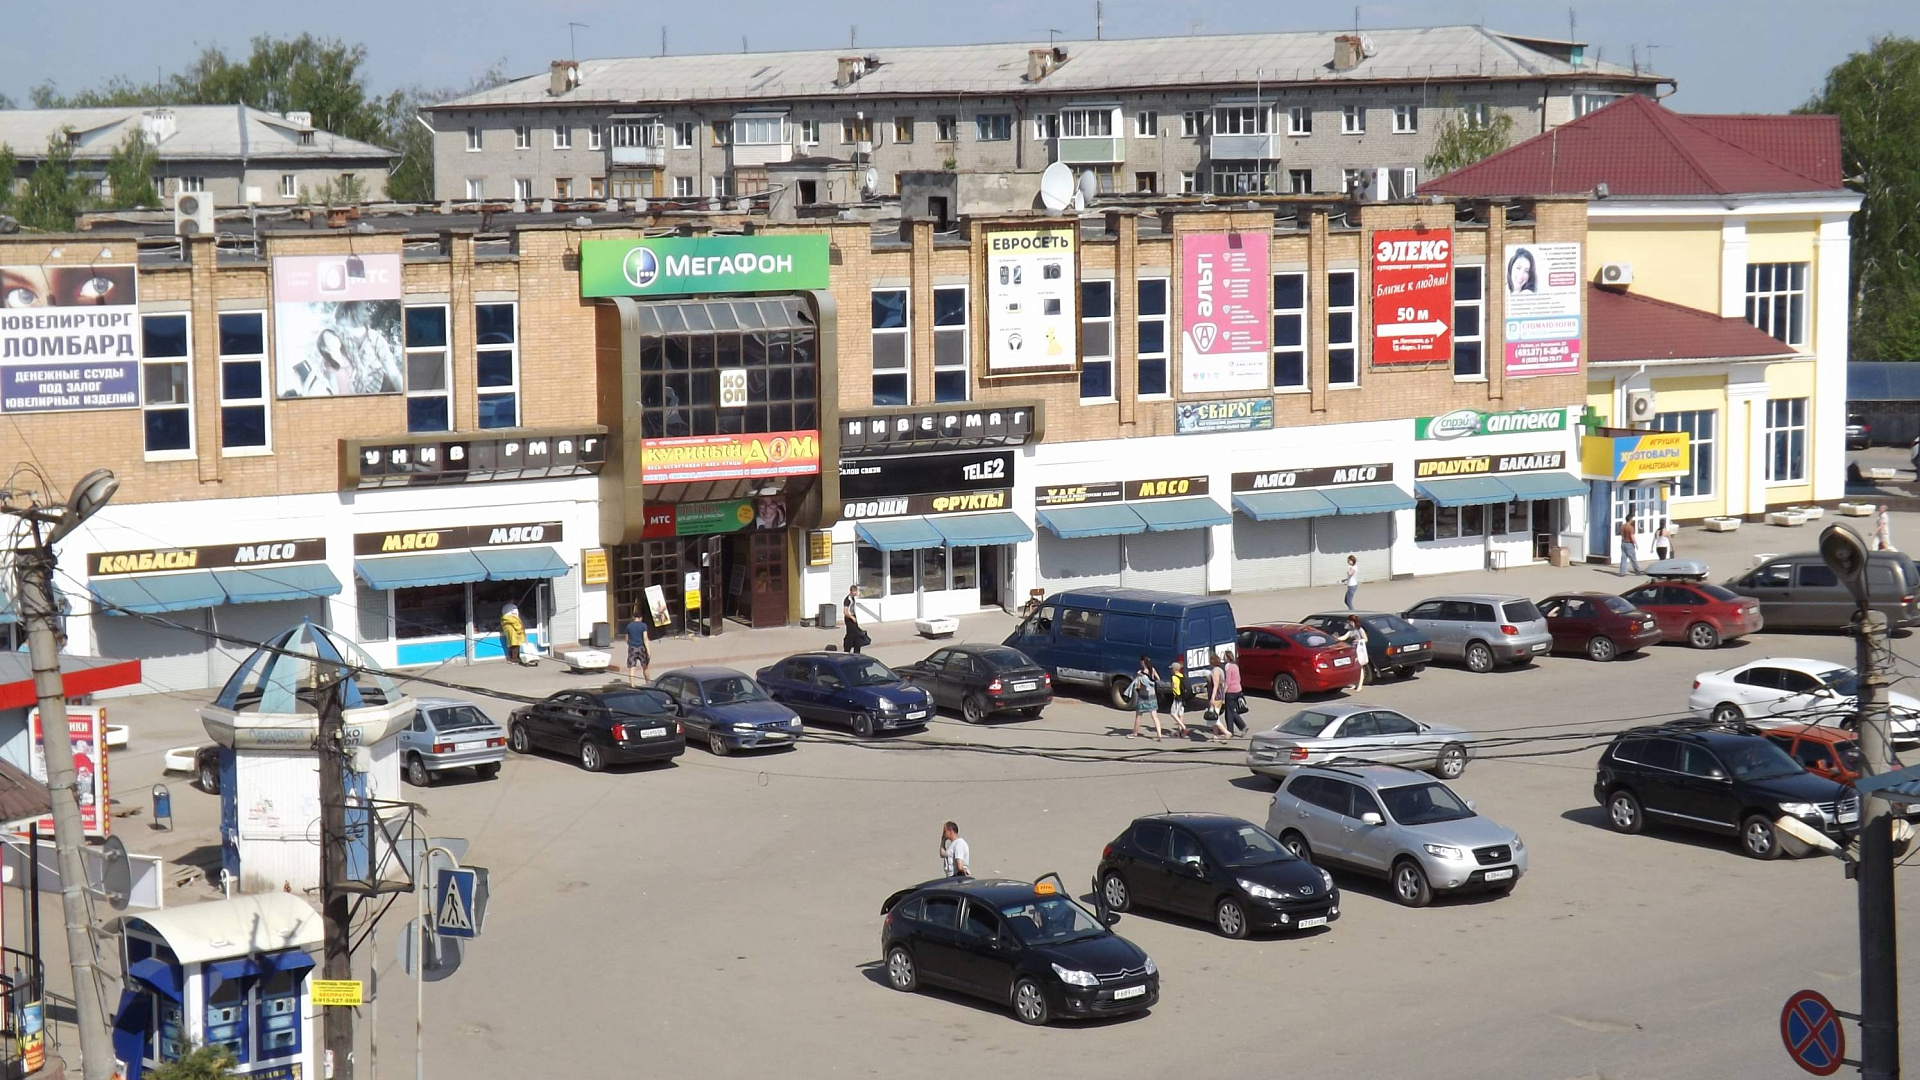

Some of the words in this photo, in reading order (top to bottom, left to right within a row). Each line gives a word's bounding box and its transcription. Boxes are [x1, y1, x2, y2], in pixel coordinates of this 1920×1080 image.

[993, 236, 1068, 250] ЕВРОСЕТЬ
[1376, 240, 1449, 262] ЭЛЕКС
[665, 252, 792, 276] МЕГАФОН
[350, 269, 389, 285] ТС
[1376, 284, 1405, 297] Ближе
[1407, 282, 1414, 291] к
[1415, 272, 1449, 290] людям!
[1, 313, 132, 330] ЮВЕЛИРТОРГ
[1397, 307, 1415, 321] 50
[1417, 309, 1429, 320] м
[1522, 321, 1576, 330] СТОМАТОЛОГИЯ
[3, 334, 134, 358] ЛОМБАРД
[15, 369, 80, 383] ДЕНЕЖНЫЕ
[84, 368, 124, 379] ССУДЫ
[723, 375, 745, 388] КО
[39, 383, 63, 394] ПОД
[66, 381, 102, 393] ЗАЛОГ
[723, 389, 746, 402] ОП
[5, 395, 80, 408] ЮВЕЛИРНЫХ
[83, 392, 135, 406] ИЗДЕЛИЙ
[1199, 402, 1256, 420] СВАРОГ
[849, 411, 1025, 435] НИВЕРМАГ
[1487, 411, 1560, 432] аптека
[647, 439, 742, 461] КУРИНЫЙ
[744, 435, 813, 464] ДОМ
[1650, 437, 1680, 445] ИГРУШКИ
[963, 458, 1005, 480] TELE2
[1418, 458, 1490, 476] ПРОДУКТЫ
[1499, 454, 1560, 471] БАКАЛЕЯ
[1639, 461, 1679, 471] КАНЦТОВАРЫ
[1253, 472, 1296, 488] МЯСО
[1333, 467, 1377, 483] МЯСО
[1138, 479, 1189, 497] МЯСО
[844, 498, 909, 518] ОВОЩИ
[933, 492, 1005, 512] ФРУКТЫ
[650, 515, 671, 525] МТС
[381, 532, 439, 551] МЯСО
[488, 525, 544, 544] МЯСО
[98, 549, 198, 574] КОЛБАСЫ
[234, 542, 296, 563] МЯСО
